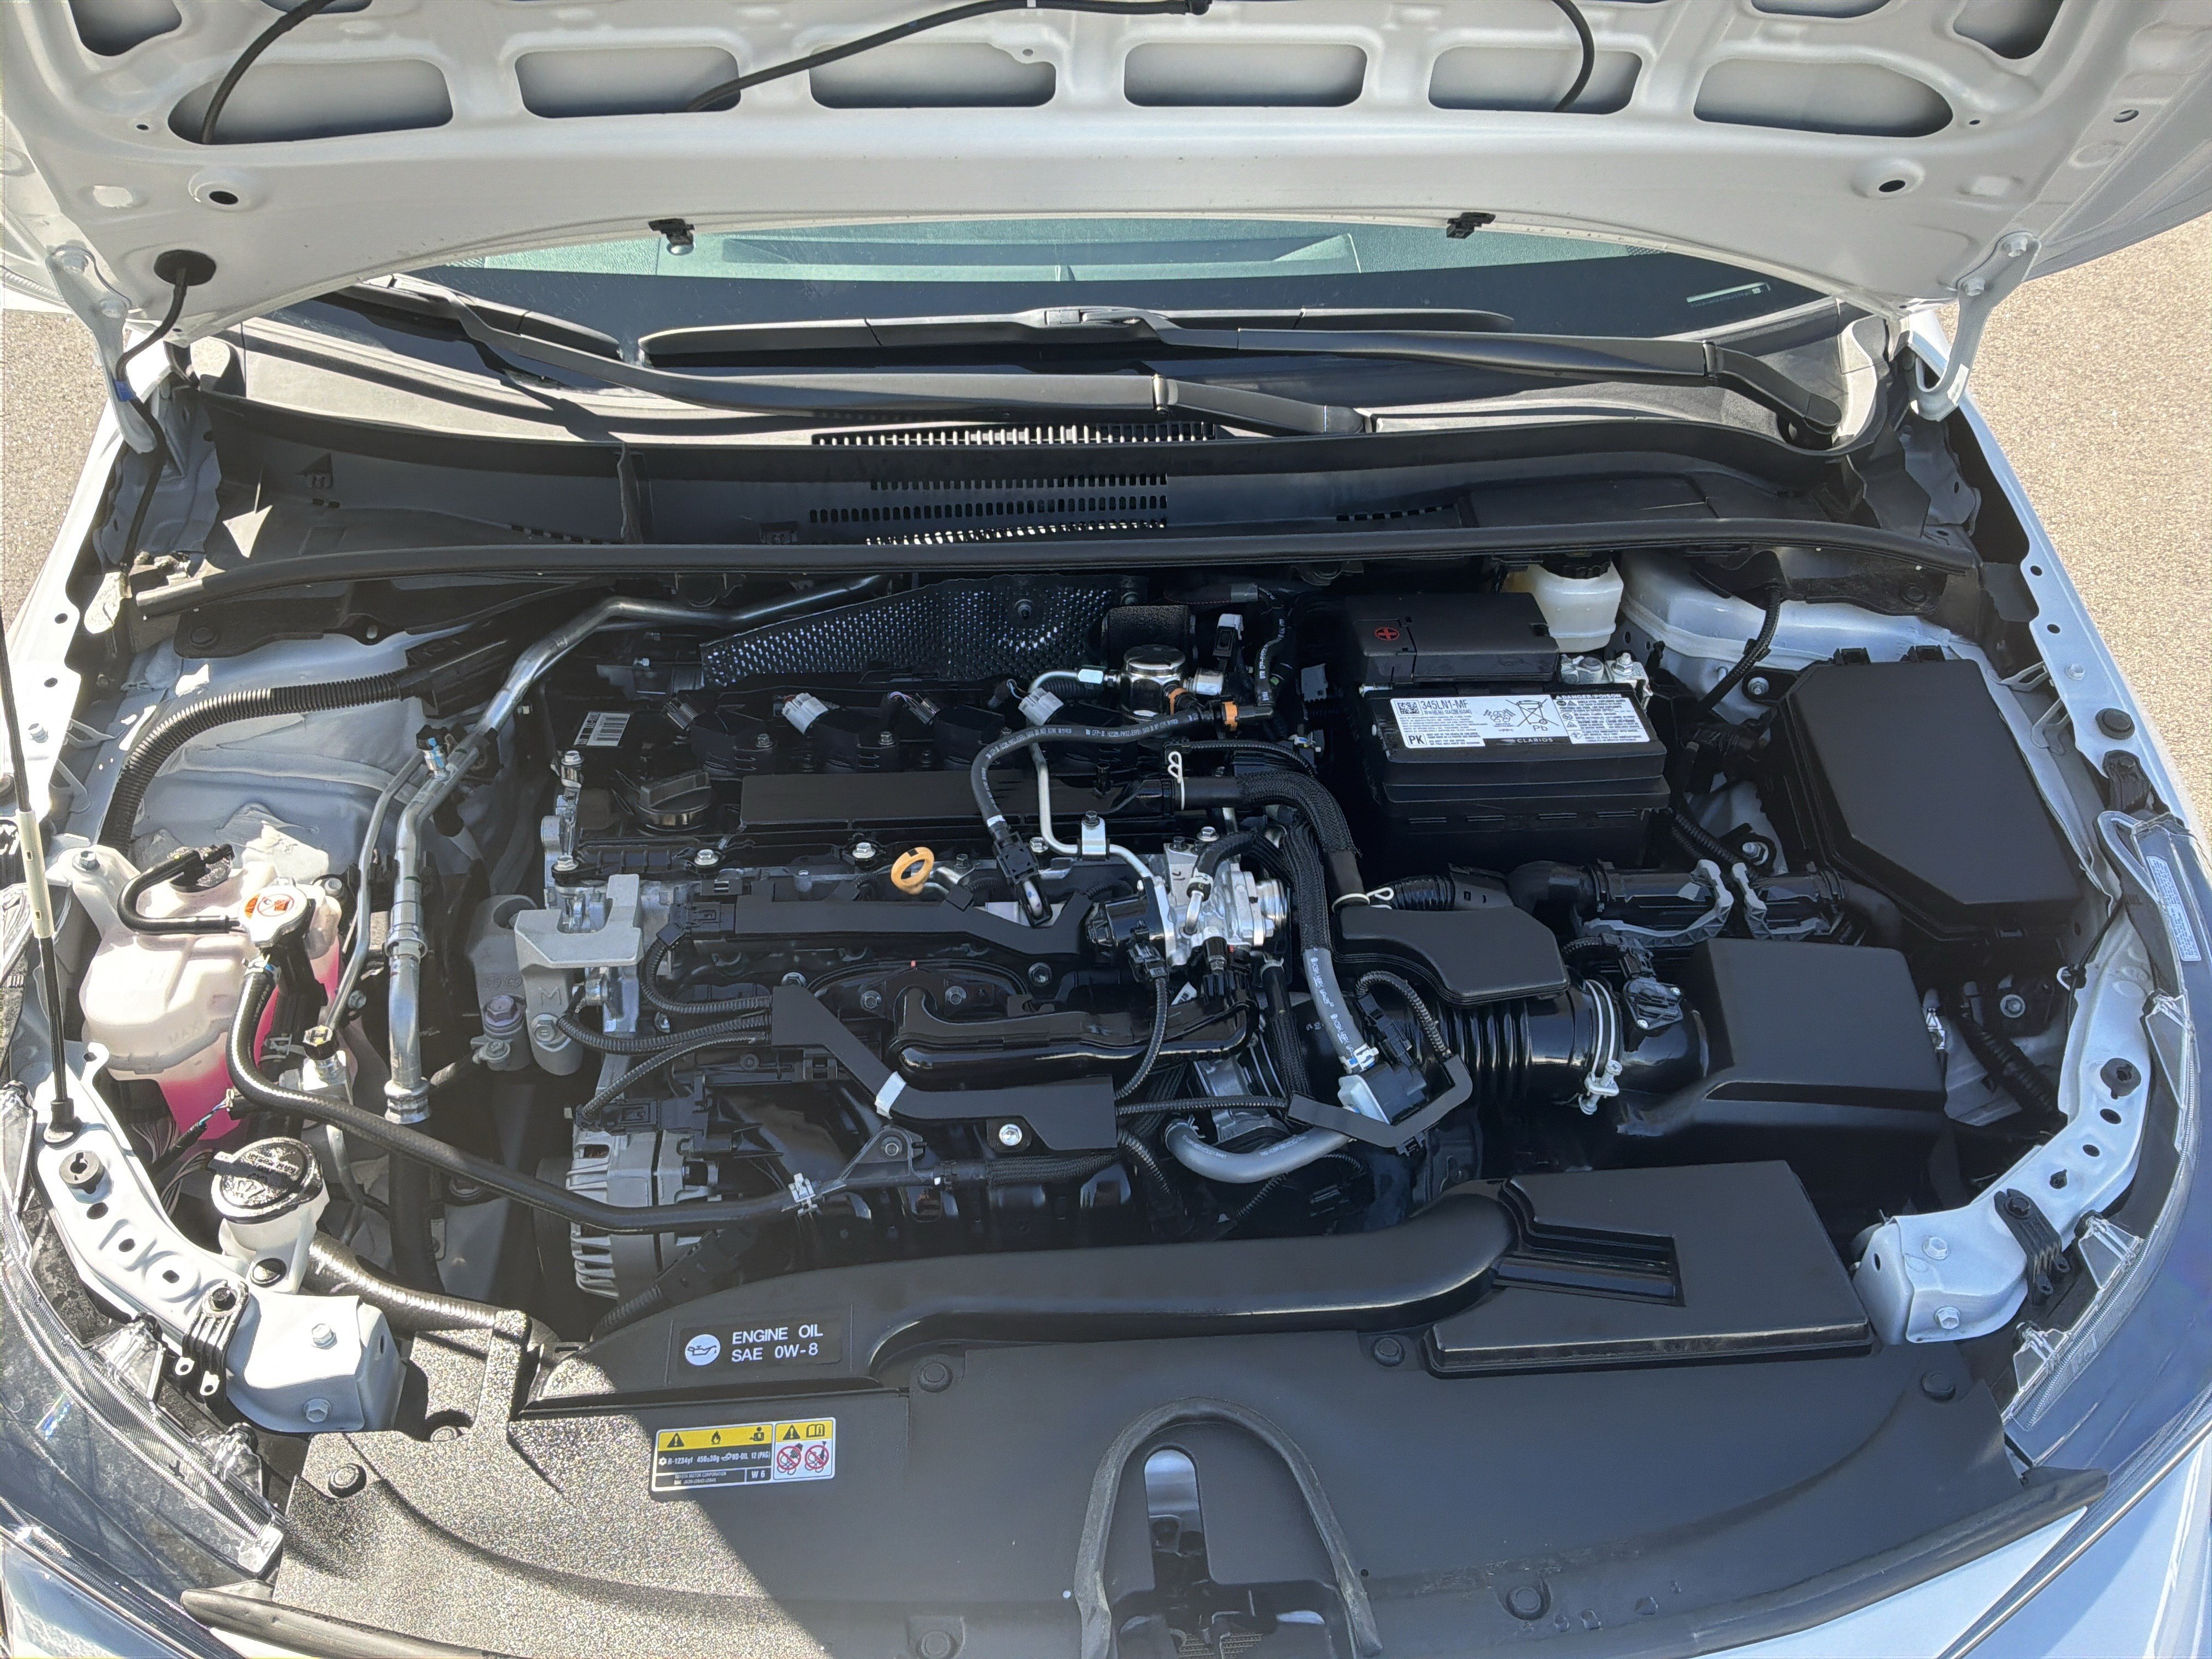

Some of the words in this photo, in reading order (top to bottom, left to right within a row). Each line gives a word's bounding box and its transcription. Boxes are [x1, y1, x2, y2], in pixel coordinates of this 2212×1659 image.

[1420, 699, 1468, 710] 345LN1-MF
[1408, 735, 1425, 745] PK
[732, 1327, 789, 1345] ENGINE
[798, 1324, 823, 1339] OIL
[731, 1347, 764, 1363] SAE
[774, 1342, 819, 1358] 0W-8
[668, 1457, 693, 1465] R-1234yf
[758, 1451, 771, 1460] (PAG)
[751, 1470, 759, 1479] W
